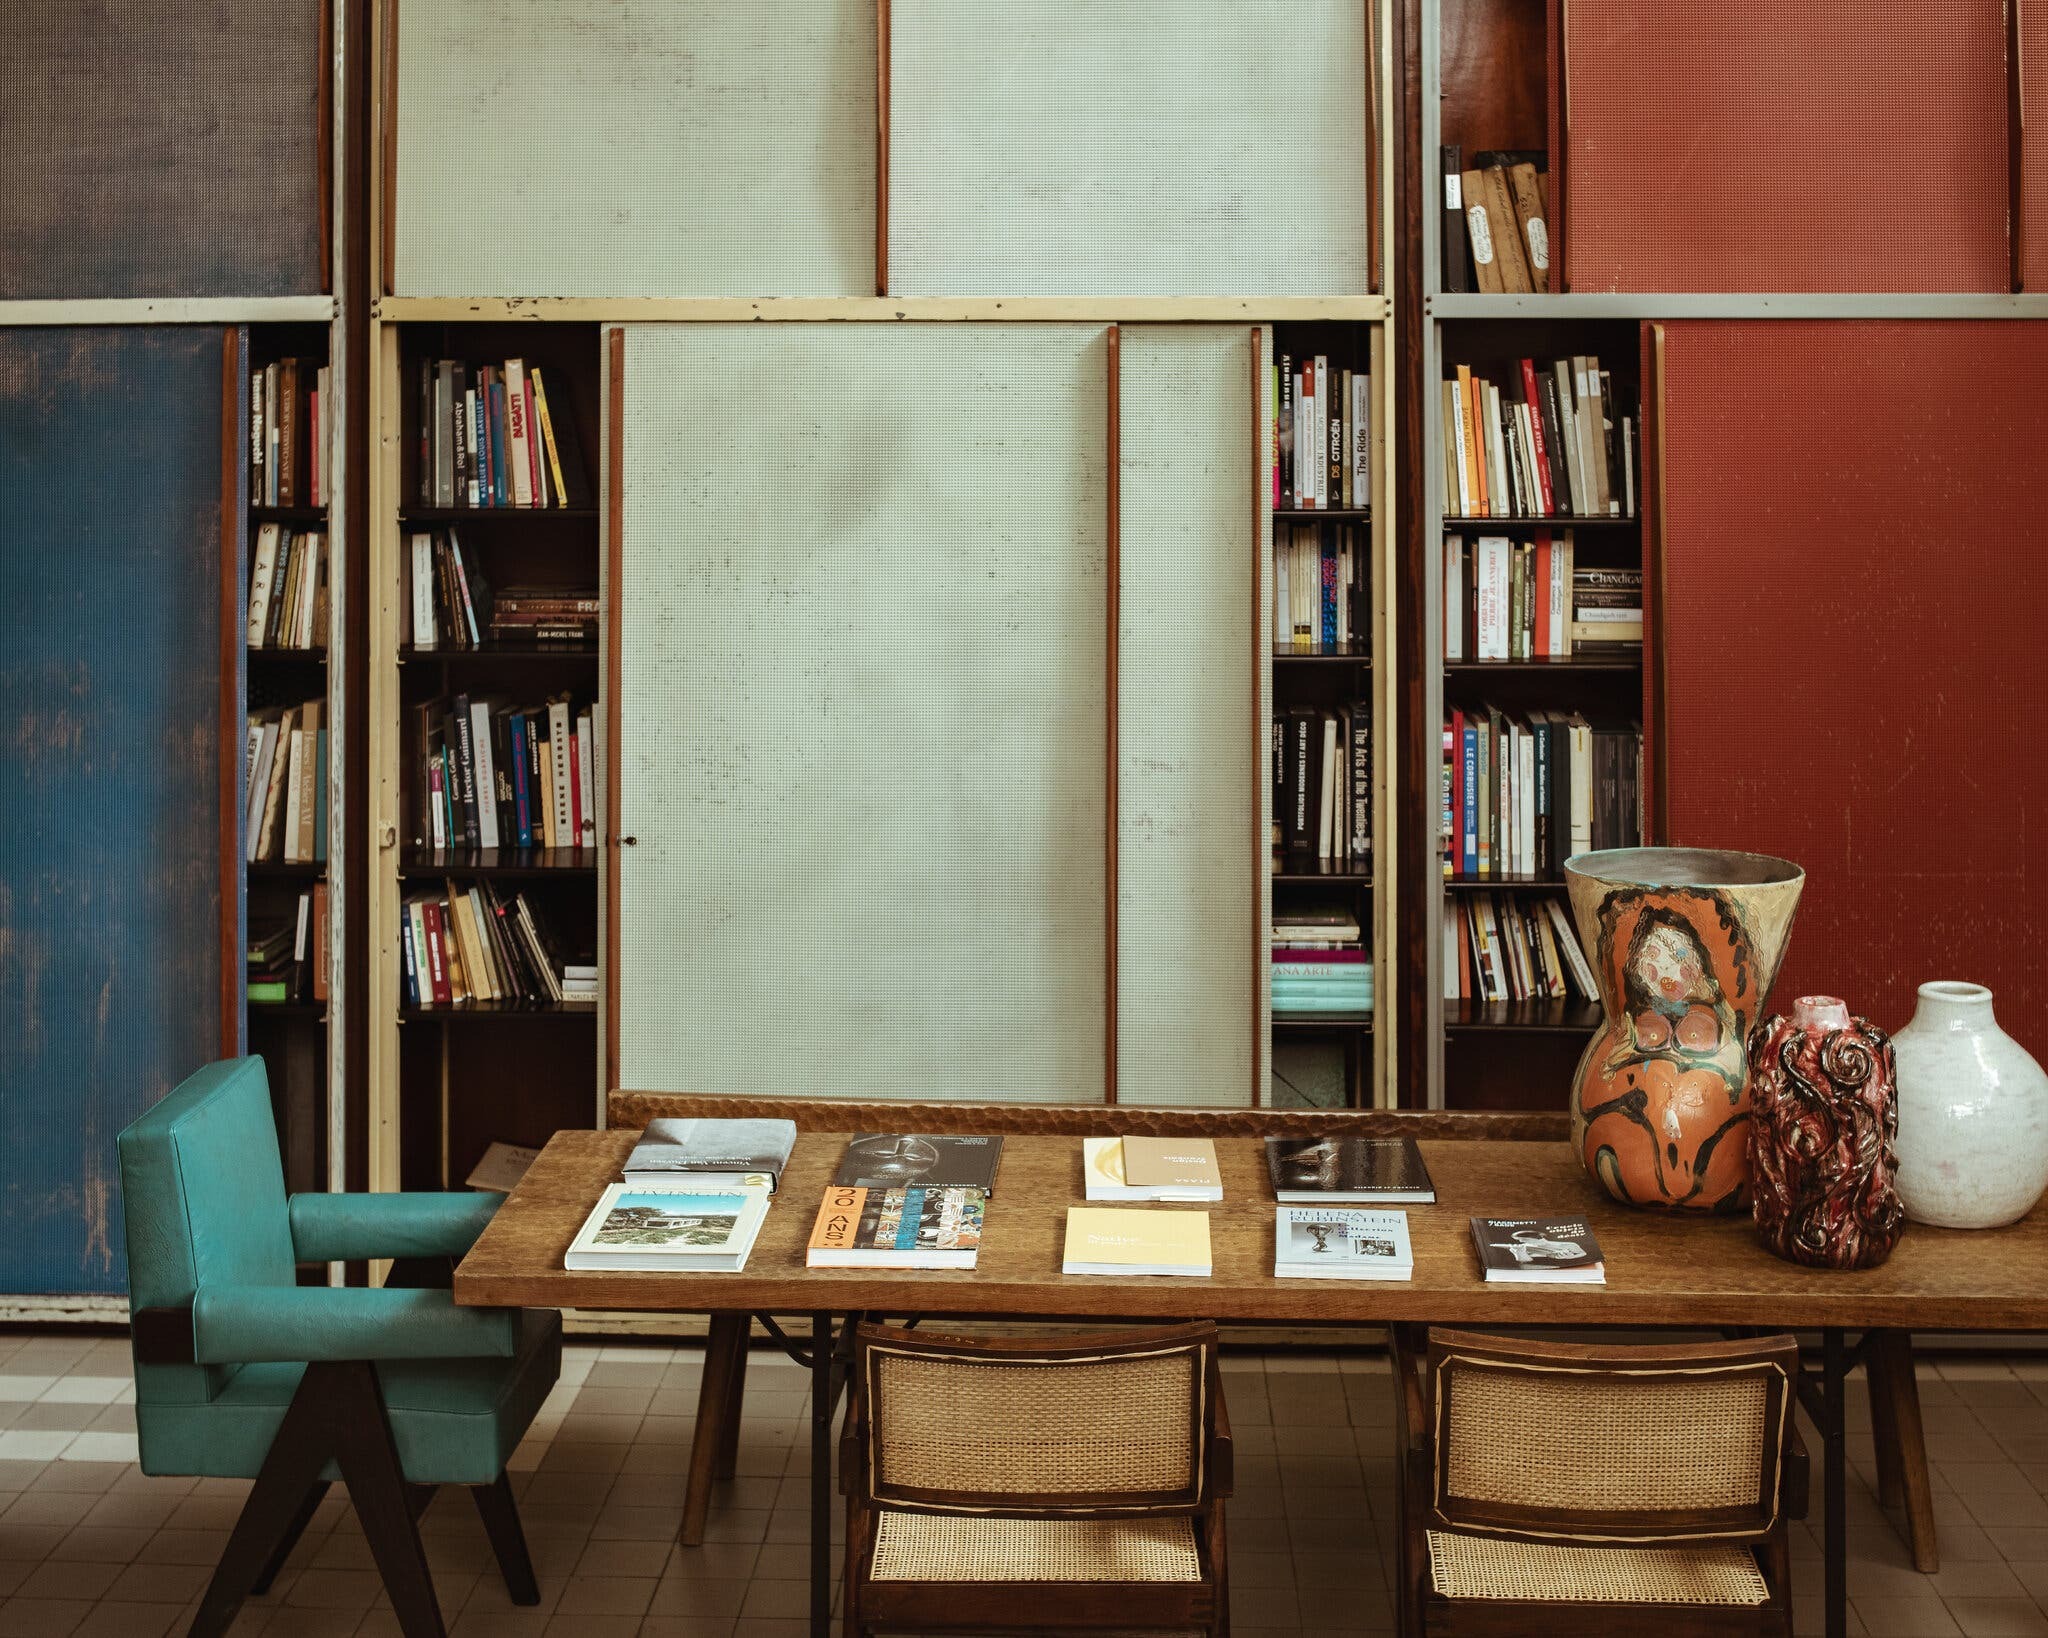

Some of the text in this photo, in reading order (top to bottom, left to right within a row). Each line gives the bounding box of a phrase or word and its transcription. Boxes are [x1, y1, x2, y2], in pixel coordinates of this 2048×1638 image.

[1283, 355, 1292, 410] Aluminum
[251, 375, 263, 464] Isamu Noguchi
[510, 393, 523, 439] BUGATTI
[1532, 406, 1540, 429] RONIS
[1330, 419, 1340, 479] DS CITROËN
[1357, 429, 1365, 452] Ride
[1464, 432, 1472, 458] LUCIEN
[1357, 456, 1366, 475] The
[1481, 634, 1488, 644] LE
[304, 730, 314, 765] Houses
[1480, 732, 1487, 740] le
[457, 718, 474, 803] Hector Guimard
[302, 774, 312, 804] Atelier
[1355, 729, 1367, 834] The Arts of the Twenties
[1466, 748, 1474, 806] LE CORBUSIER
[1303, 967, 1333, 975] ARTE
[825, 1216, 849, 1240] ANS
